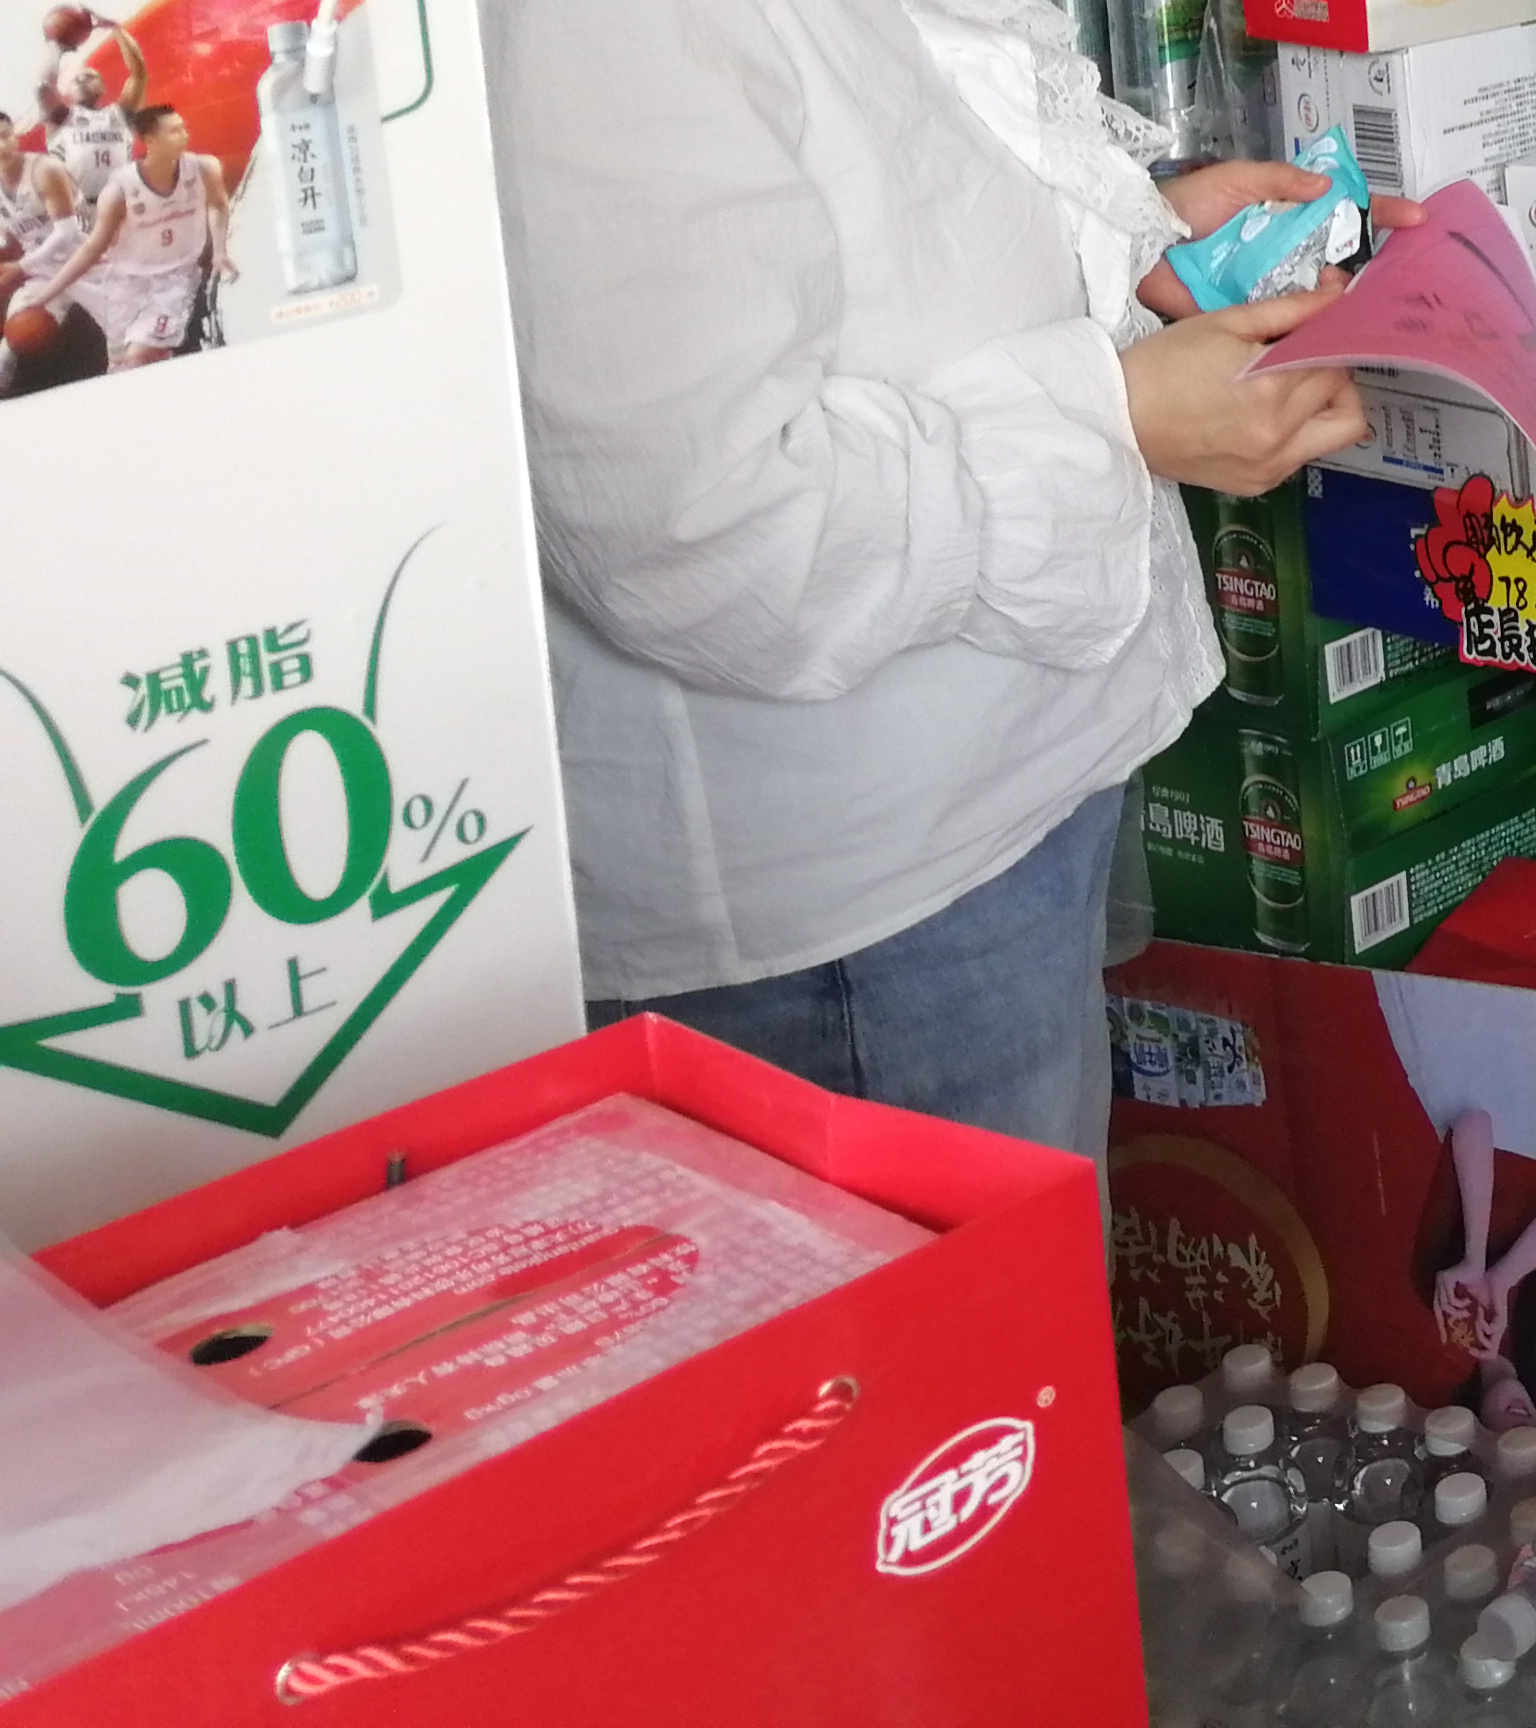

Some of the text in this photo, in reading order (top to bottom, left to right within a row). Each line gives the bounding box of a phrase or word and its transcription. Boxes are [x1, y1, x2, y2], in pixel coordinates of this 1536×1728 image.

[289, 139, 323, 211] 凉白开
[1215, 572, 1277, 601] TSINGTAO
[119, 618, 313, 732] 减脂
[64, 705, 487, 988] 60%
[1142, 802, 1225, 853] 島啤酒
[1242, 820, 1302, 852] TSINGTAO
[178, 955, 337, 1061] 以上
